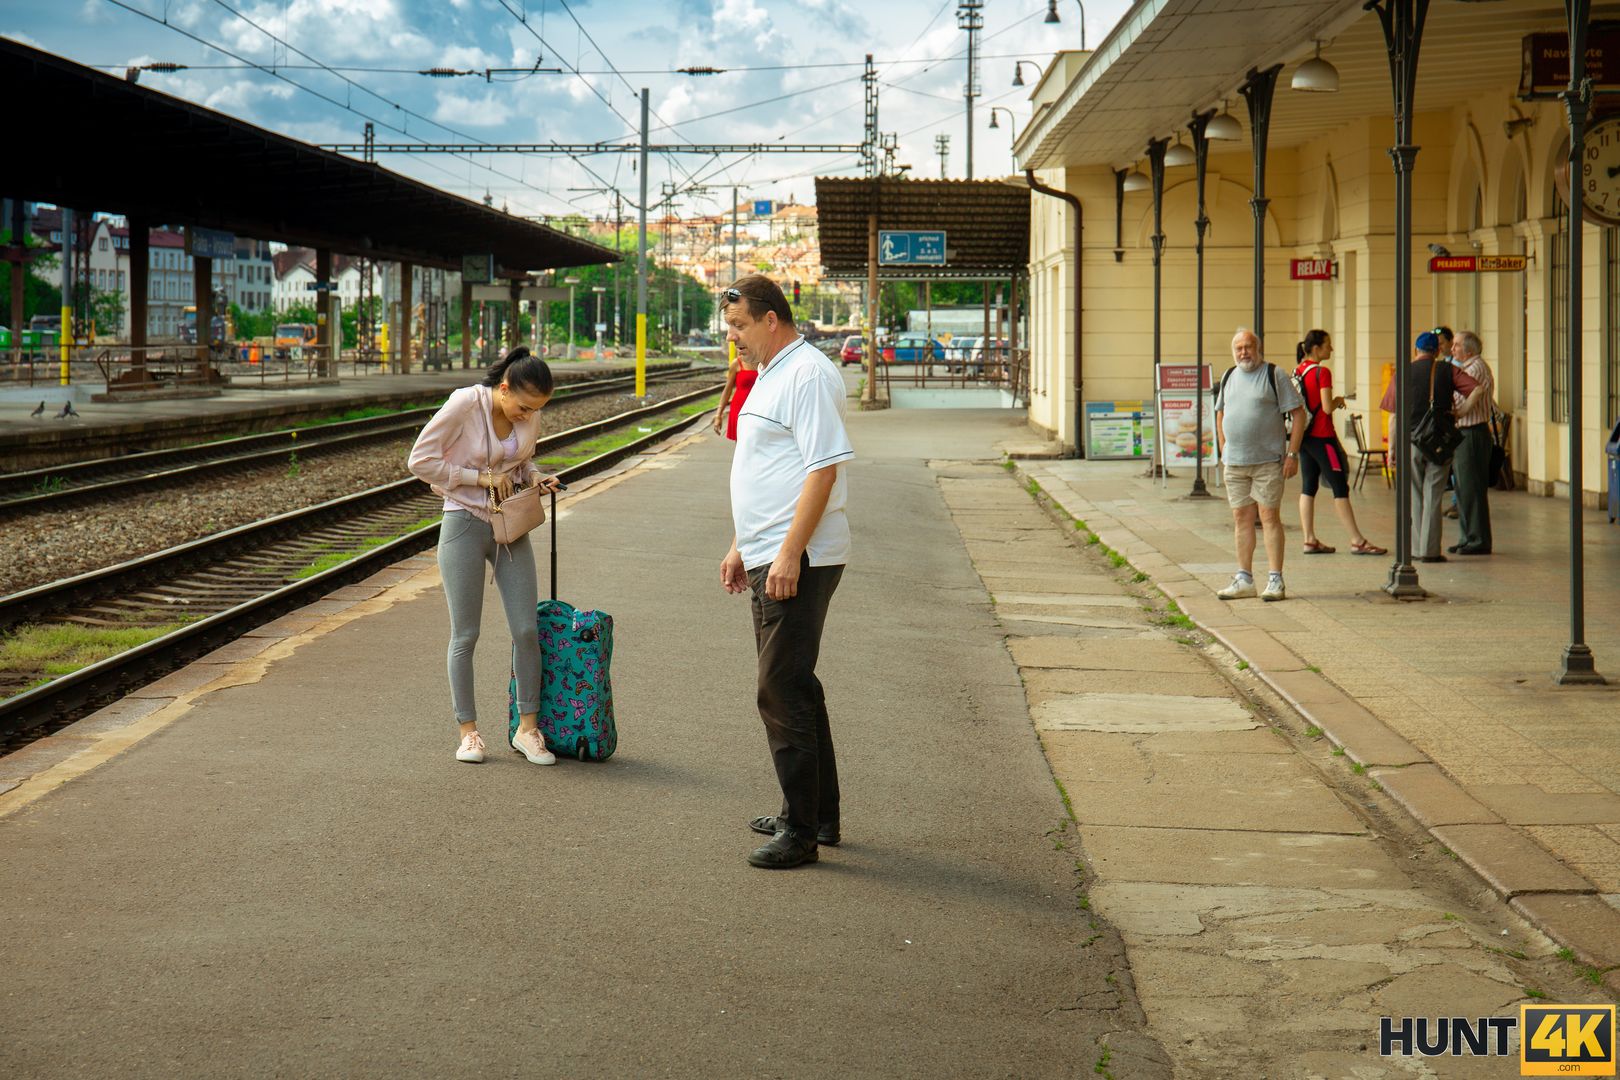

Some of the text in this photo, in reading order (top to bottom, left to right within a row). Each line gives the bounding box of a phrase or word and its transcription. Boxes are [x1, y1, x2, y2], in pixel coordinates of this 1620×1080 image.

[1601, 134, 1609, 147] 11
[1587, 146, 1599, 160] 10
[1583, 163, 1592, 176] 9
[1588, 179, 1597, 192] 8
[1601, 192, 1609, 205] 7
[1297, 260, 1328, 276] RELAY
